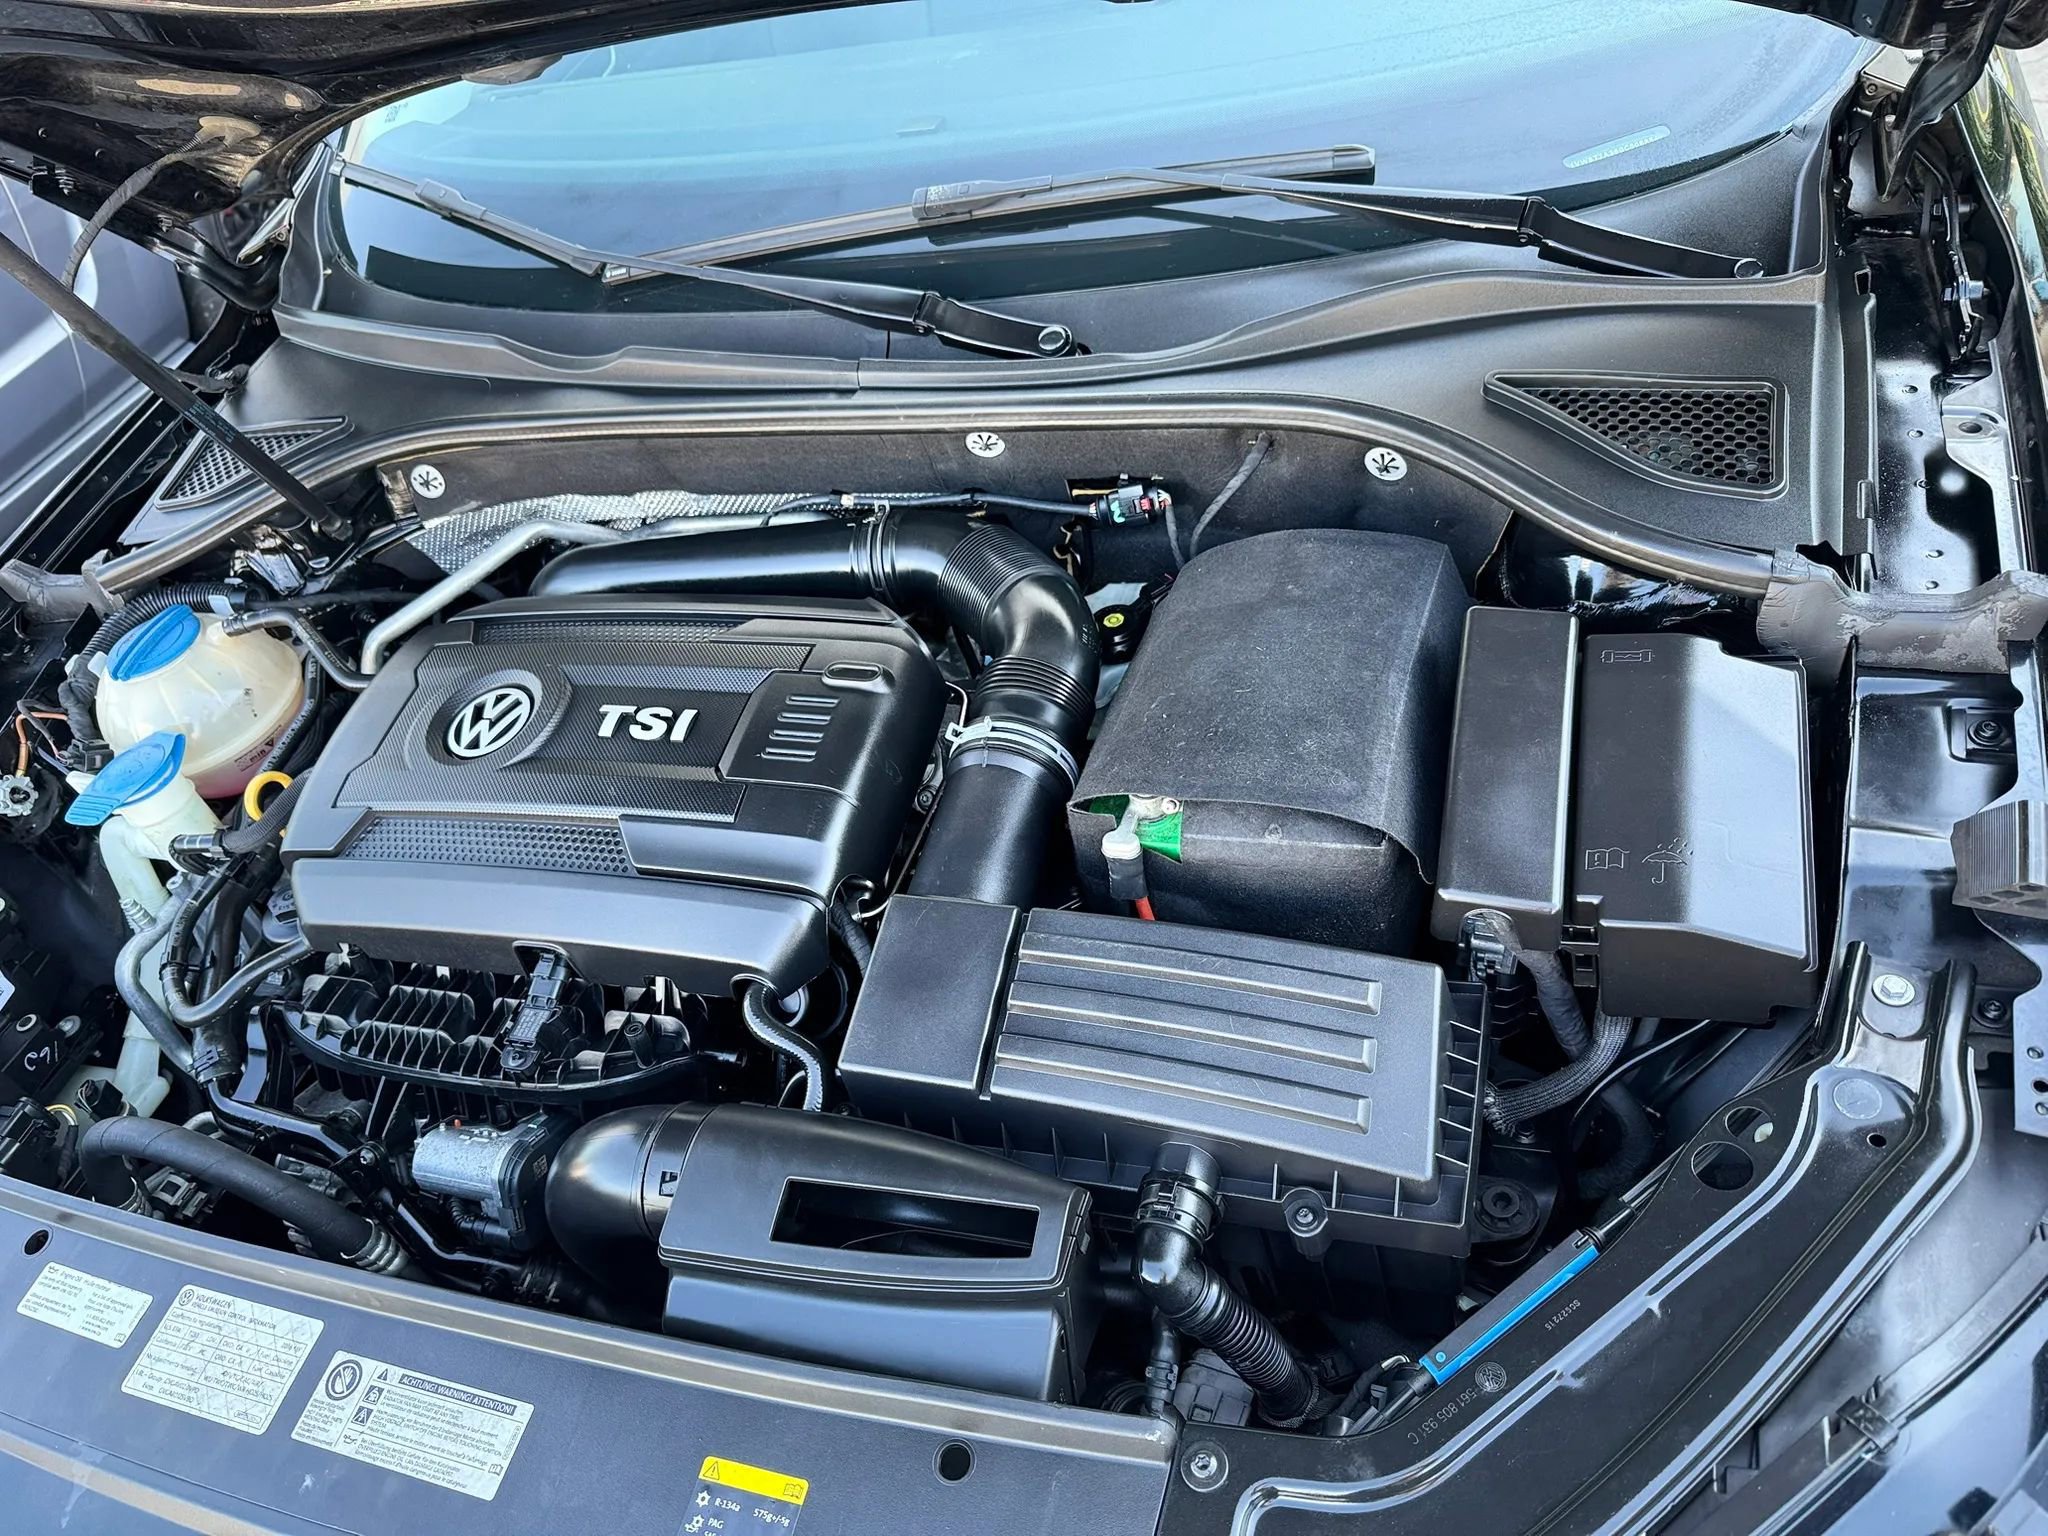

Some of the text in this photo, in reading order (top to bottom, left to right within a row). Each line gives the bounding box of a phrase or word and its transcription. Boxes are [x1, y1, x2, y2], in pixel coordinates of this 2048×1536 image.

[599, 705, 698, 742] TSI
[402, 1376, 514, 1414] ACHTUNG! WARNING! ATTENTION!
[1436, 1402, 1459, 1424] 805
[707, 1517, 724, 1529] PAG
[714, 1497, 791, 1527] R-134a 575g+/-5g
